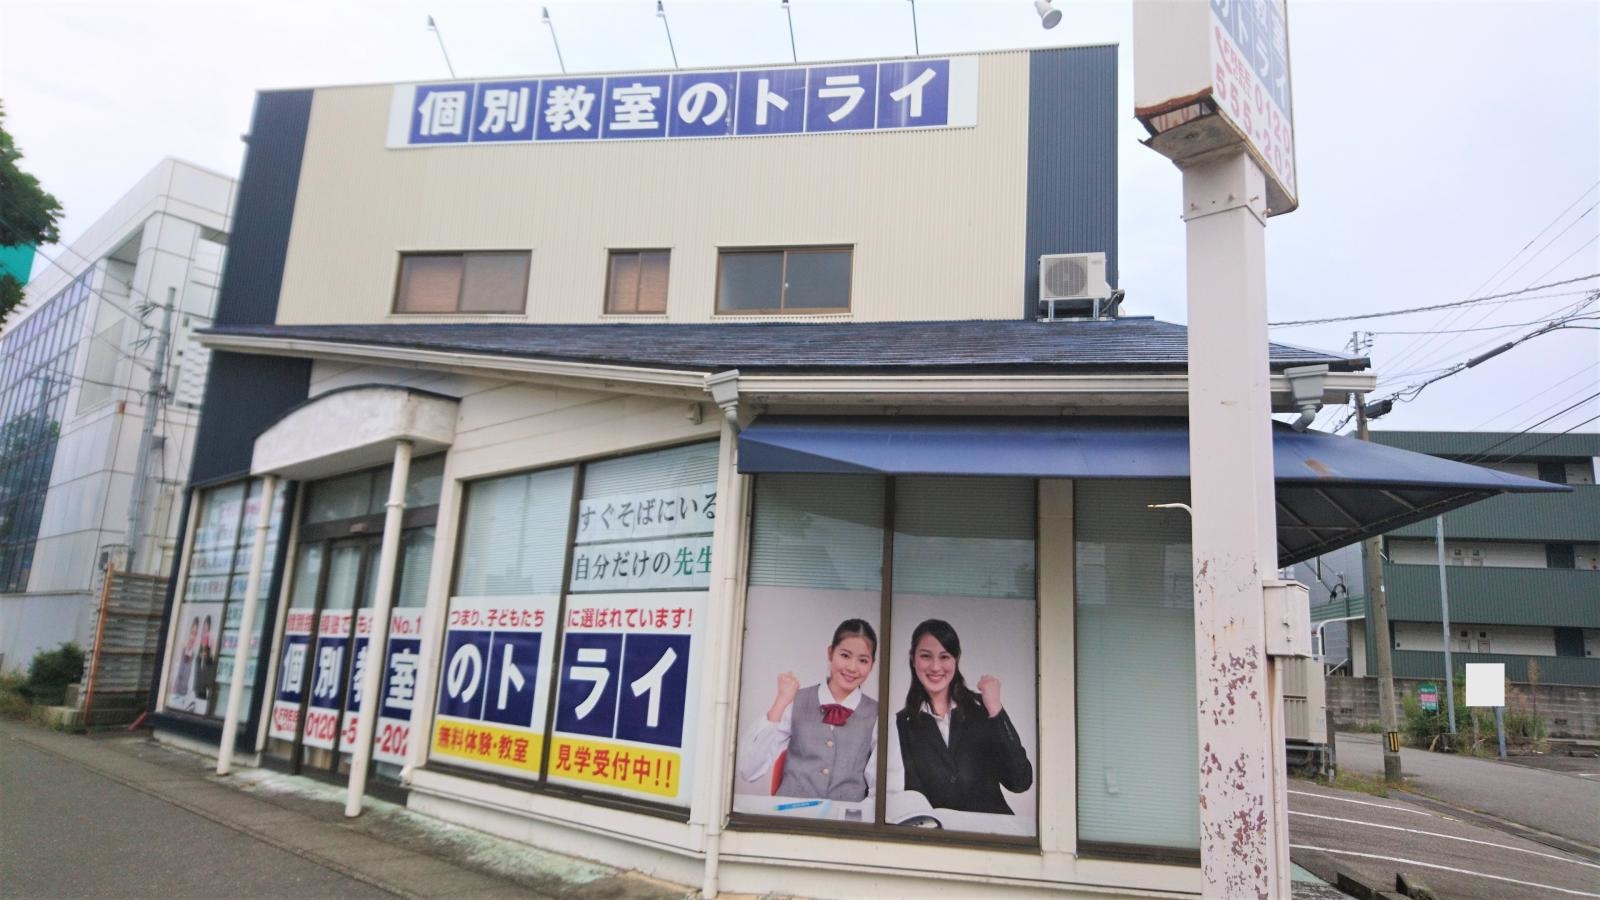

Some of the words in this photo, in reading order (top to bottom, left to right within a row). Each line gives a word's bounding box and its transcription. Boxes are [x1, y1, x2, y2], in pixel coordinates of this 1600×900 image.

[418, 68, 936, 135] 個別教室のトライ
[581, 492, 717, 532] すぐそばにいる
[575, 546, 712, 580] 自分だけの先生
